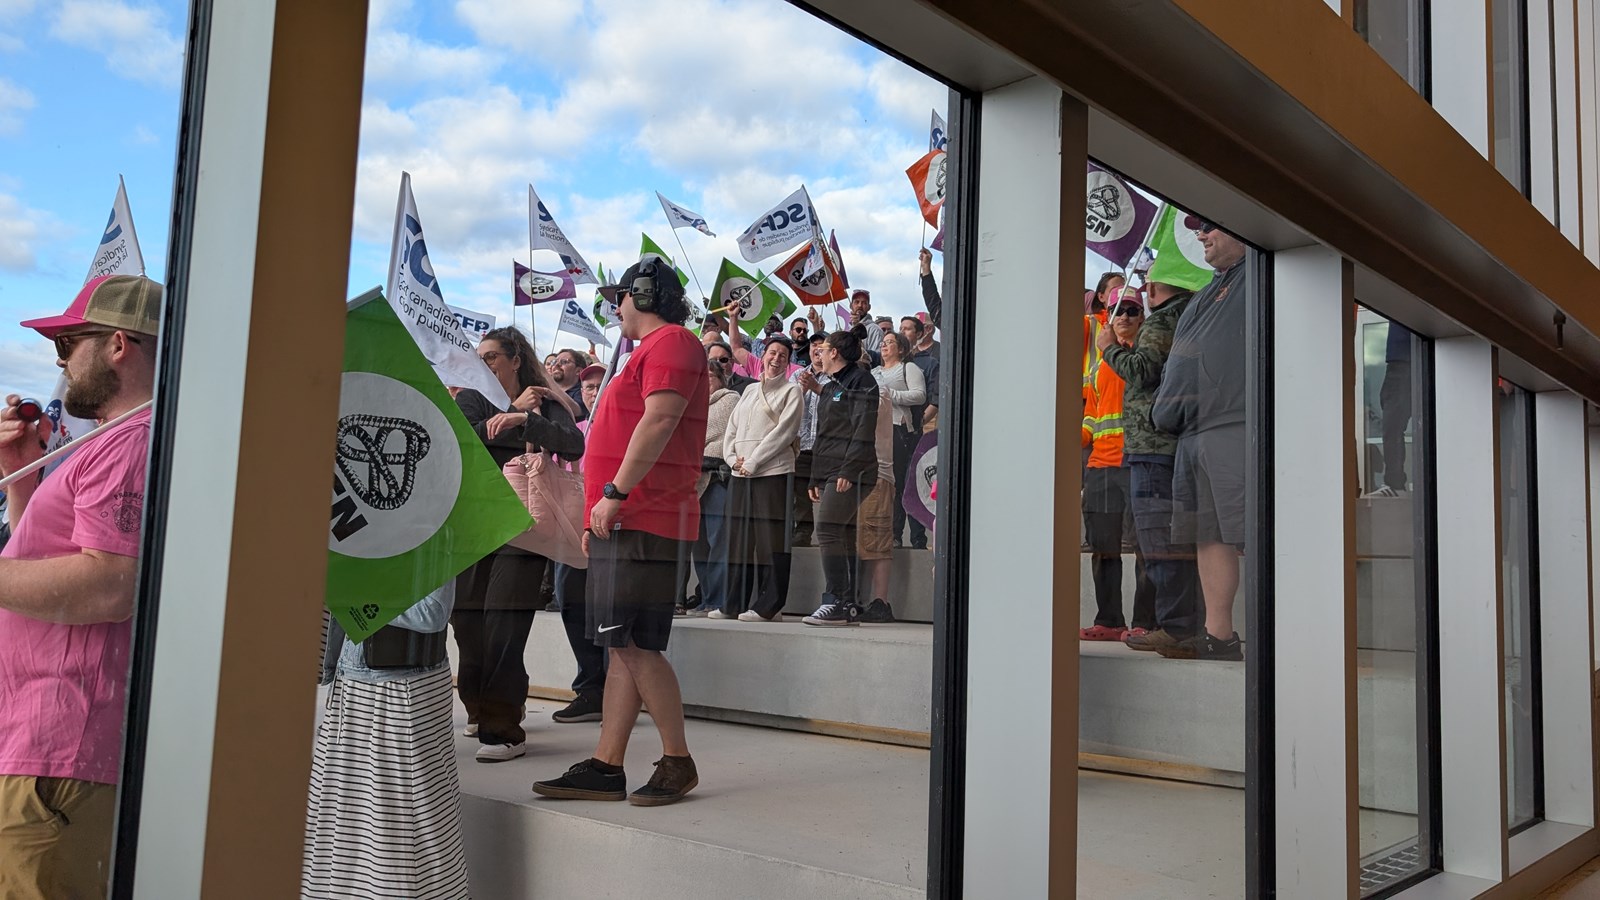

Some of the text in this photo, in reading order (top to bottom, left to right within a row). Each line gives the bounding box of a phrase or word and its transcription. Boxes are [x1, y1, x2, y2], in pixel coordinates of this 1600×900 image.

[532, 285, 554, 294] CSN
[409, 291, 461, 331] canadien
[416, 313, 470, 352] publique
